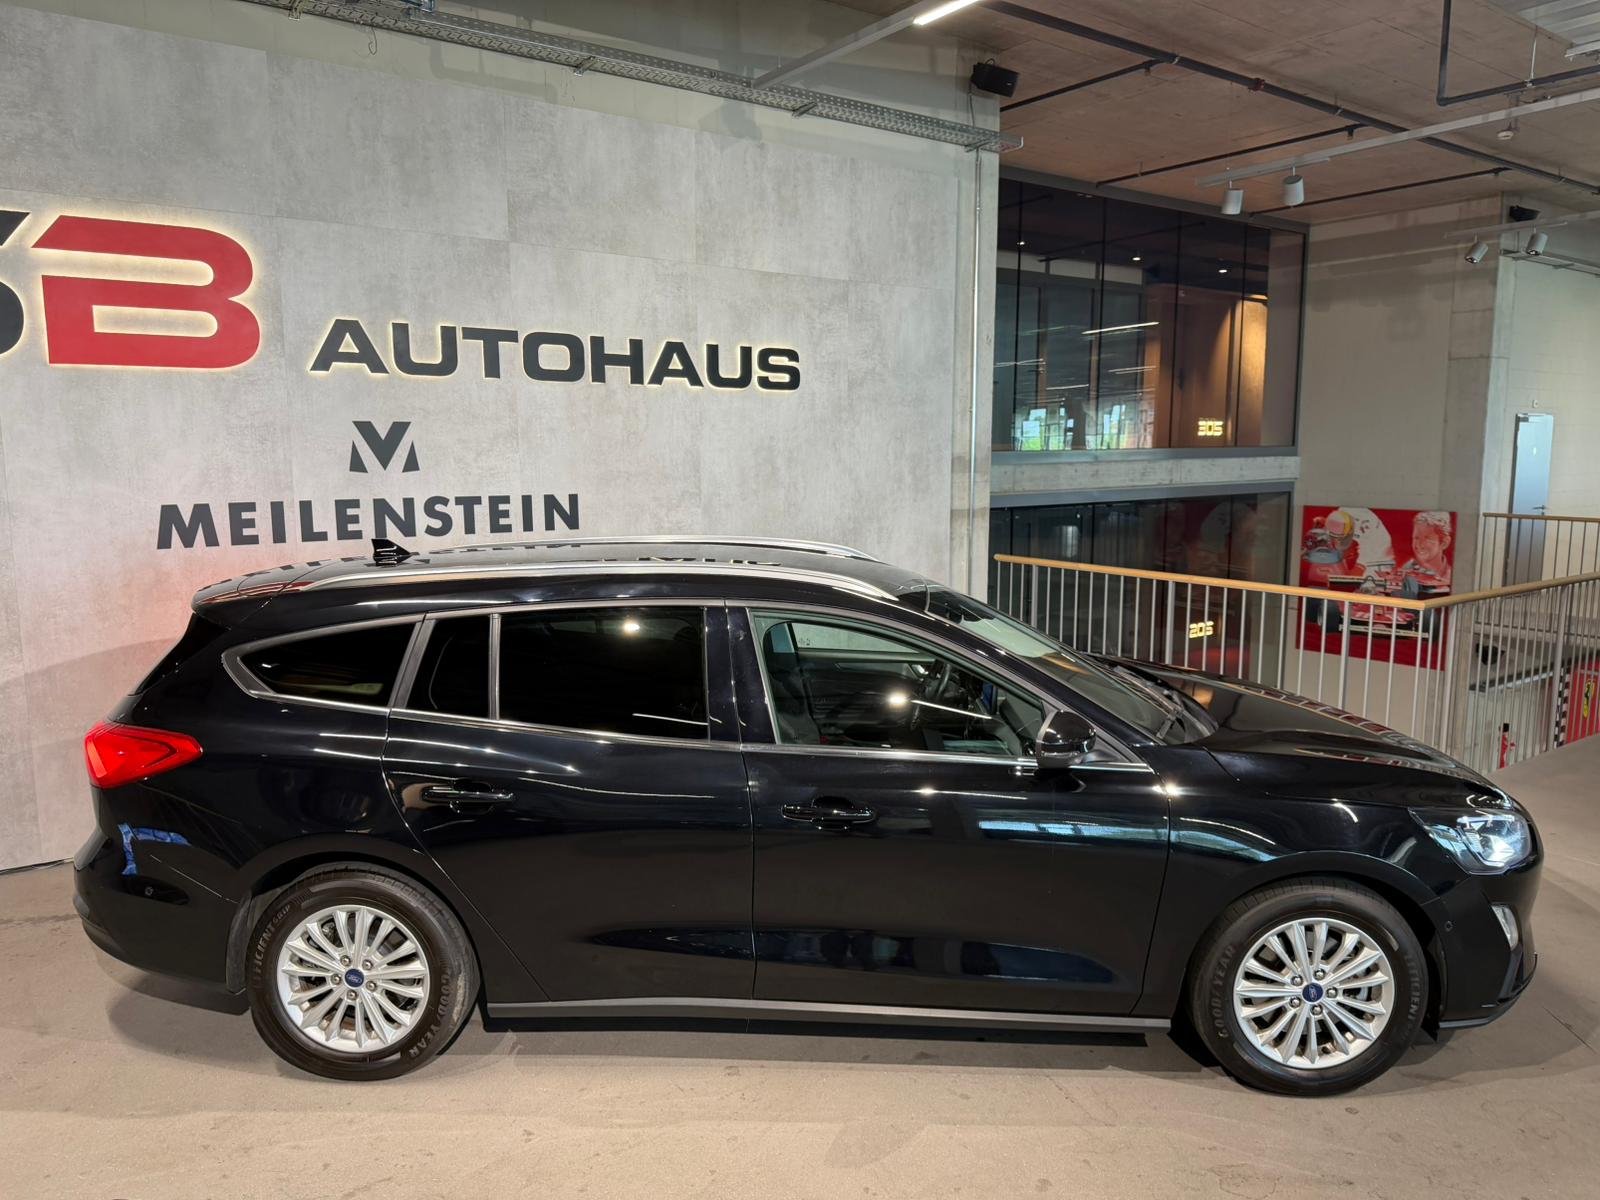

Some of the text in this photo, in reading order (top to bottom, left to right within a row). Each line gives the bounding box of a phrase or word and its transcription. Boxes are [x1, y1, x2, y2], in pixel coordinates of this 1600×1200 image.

[310, 319, 800, 389] AUTOHAUS
[1198, 421, 1223, 436] 305
[157, 494, 579, 550] MEILENSTEIN
